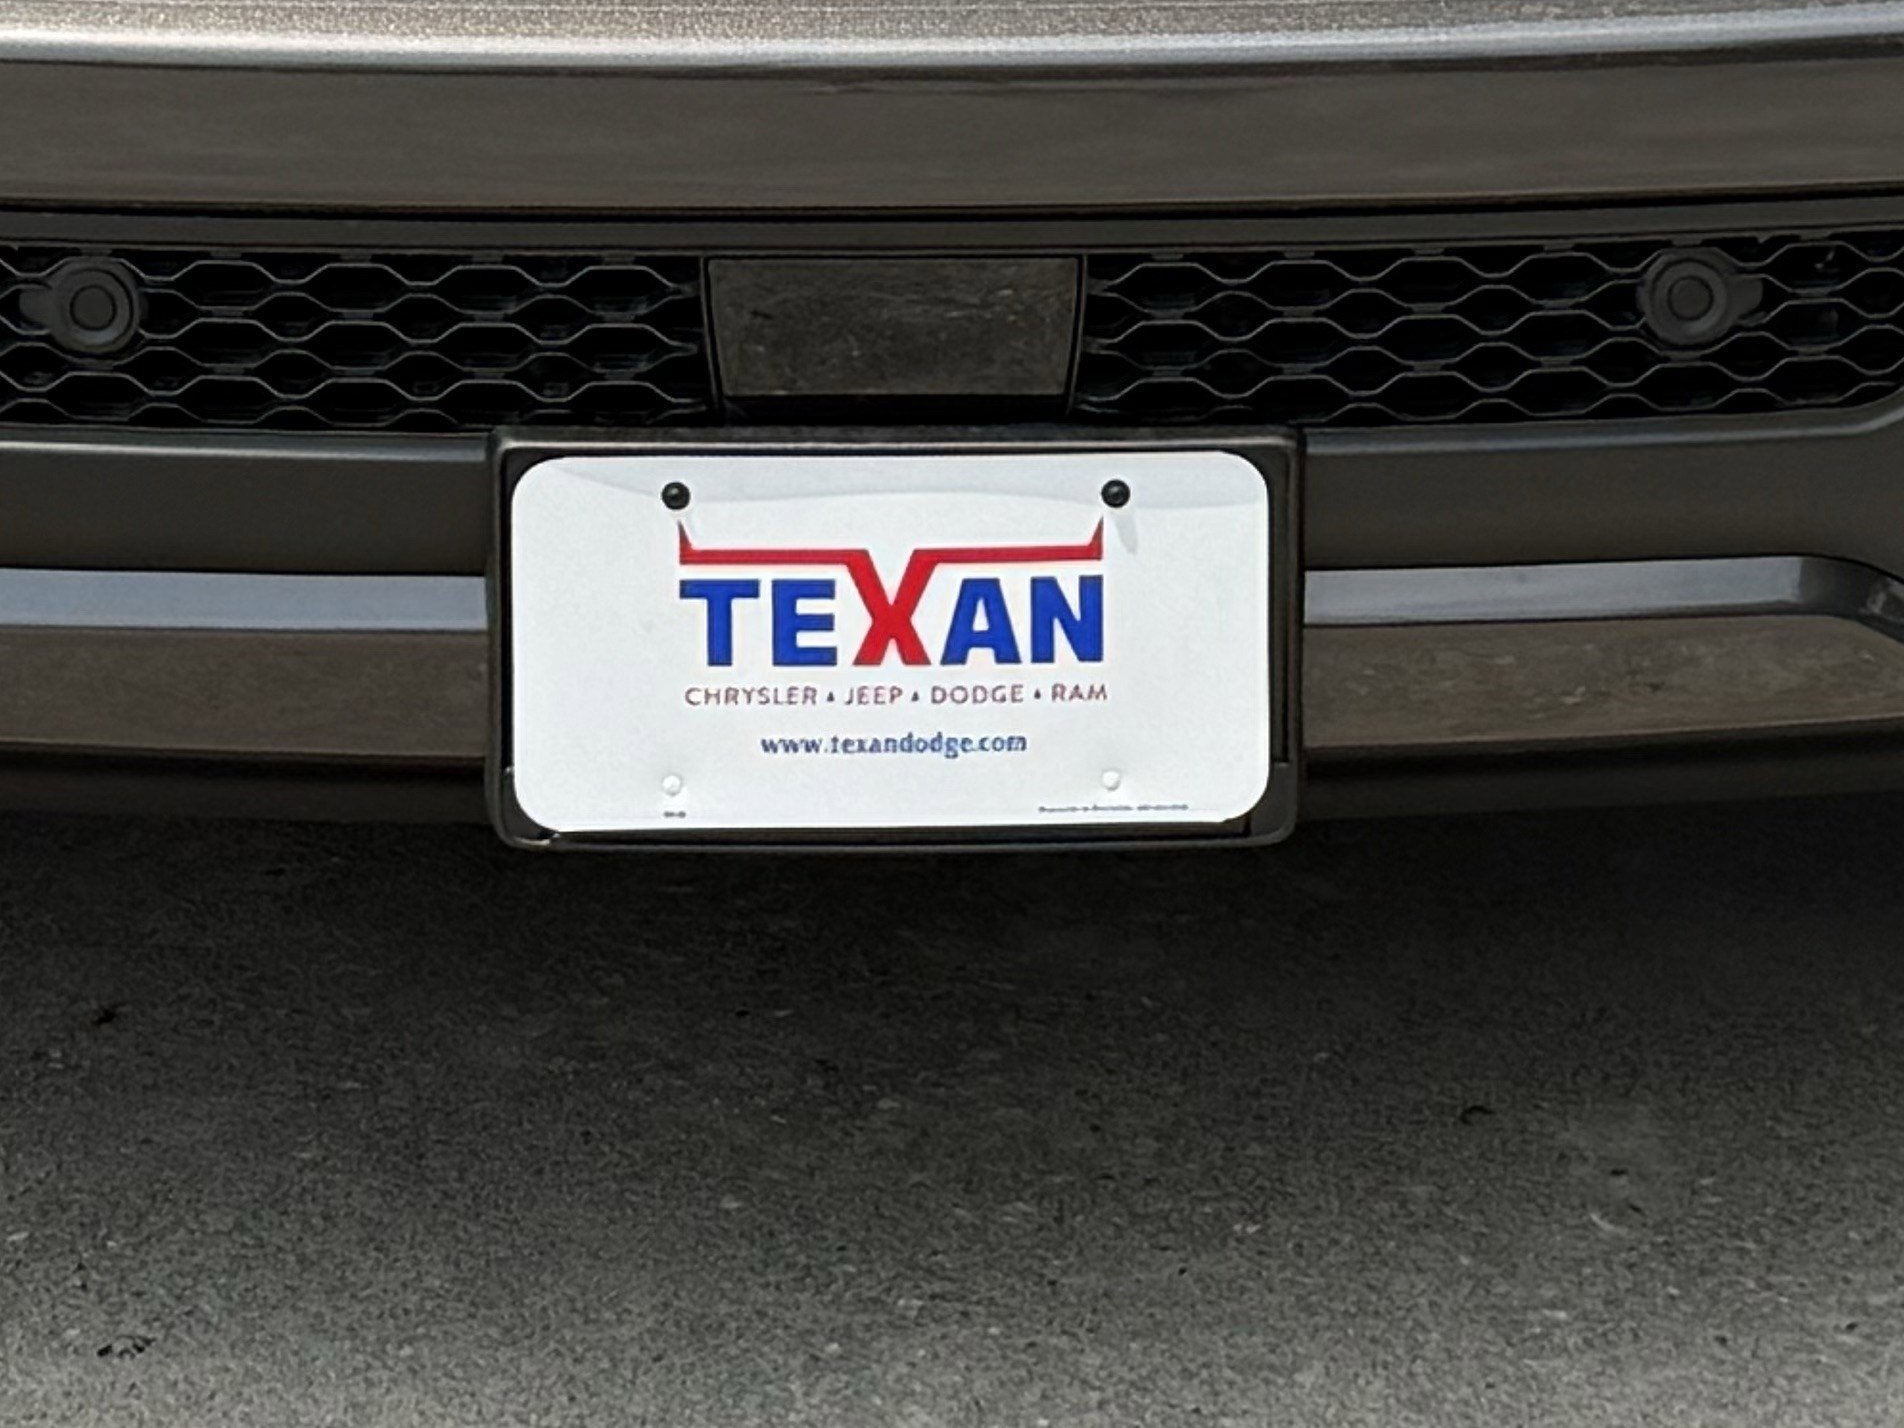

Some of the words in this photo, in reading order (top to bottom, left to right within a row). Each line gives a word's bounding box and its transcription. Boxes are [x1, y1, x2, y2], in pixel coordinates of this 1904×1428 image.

[679, 544, 1104, 667] TEXAN
[684, 686, 818, 706] CHRYSLER
[845, 685, 903, 705] JEEP
[930, 684, 1024, 704] DODGE
[1051, 683, 1108, 702] RAM
[760, 730, 1028, 760] www.texandodge.com
